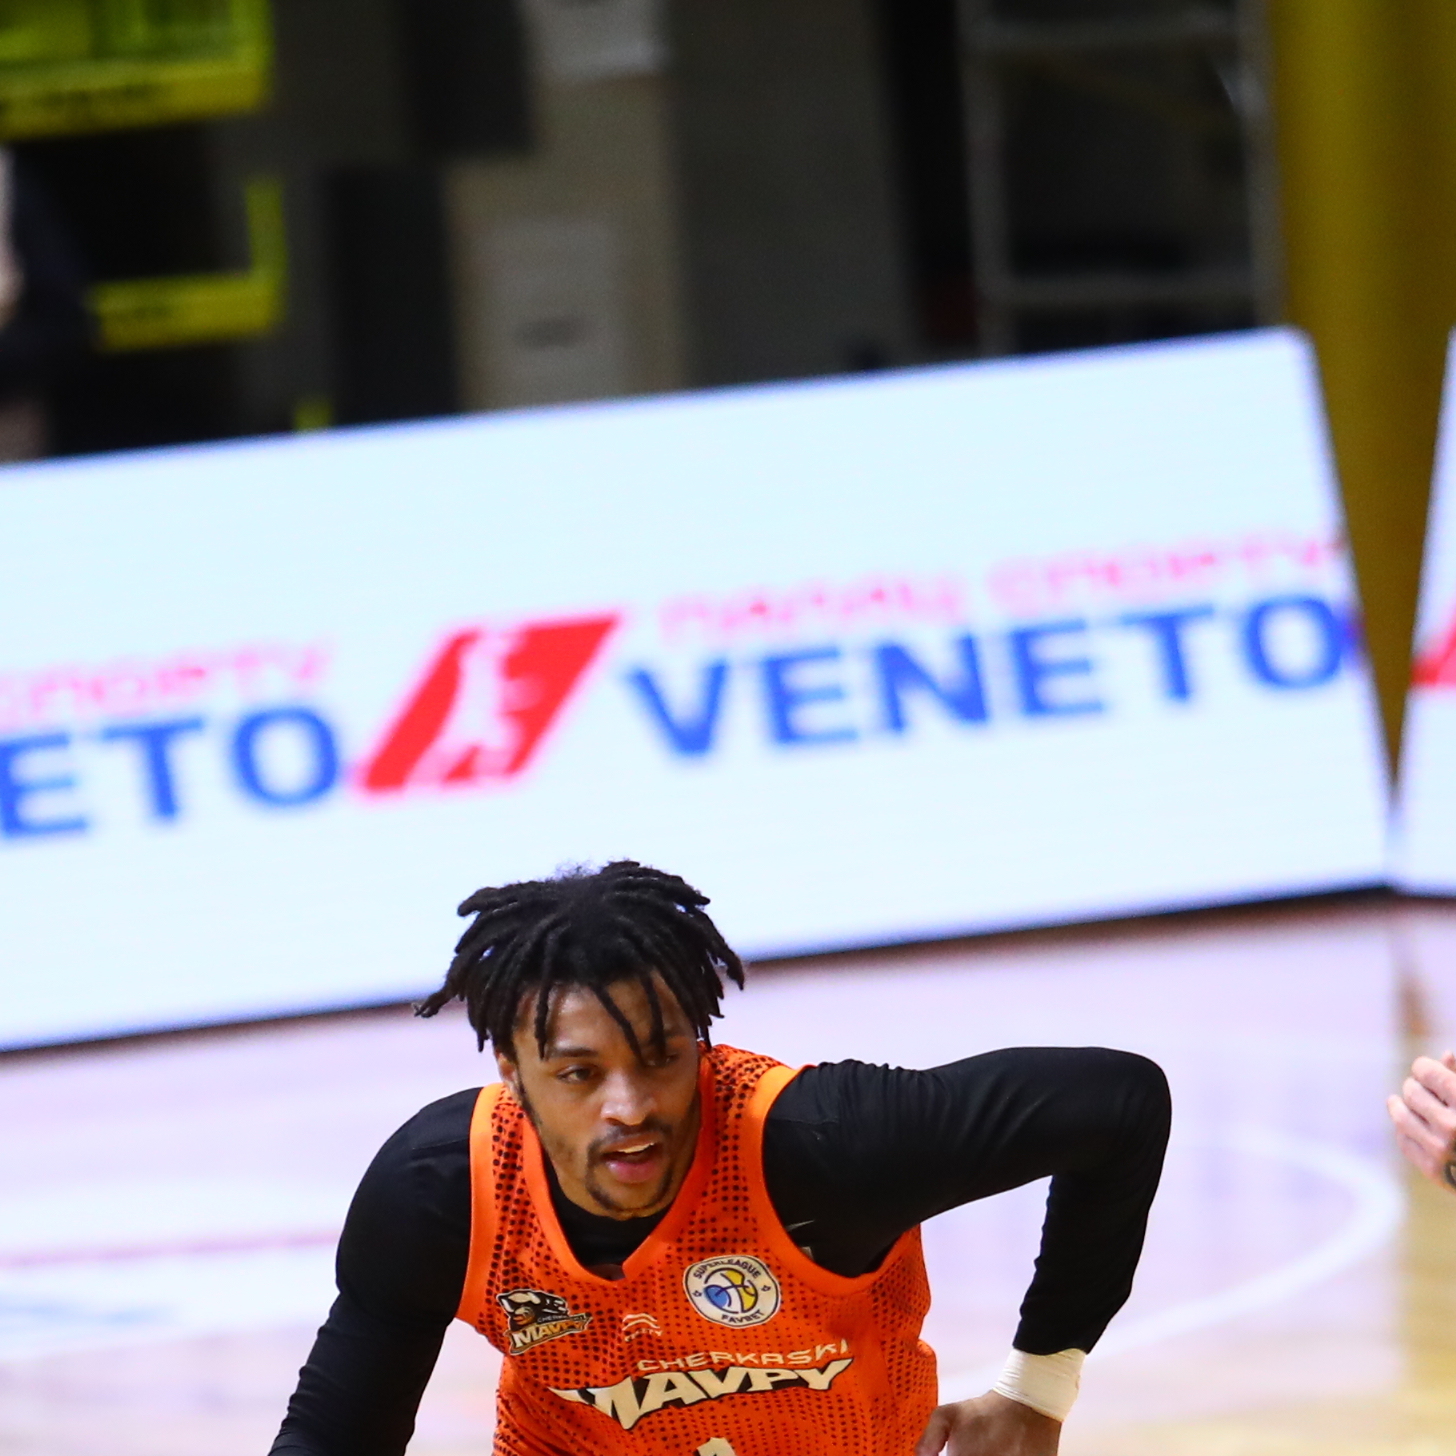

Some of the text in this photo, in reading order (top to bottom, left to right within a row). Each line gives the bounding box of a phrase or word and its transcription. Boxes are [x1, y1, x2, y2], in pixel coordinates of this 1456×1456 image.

[628, 594, 1358, 758] VENETO
[693, 1259, 762, 1280] SUPERLEAGUE
[721, 1309, 765, 1324] FAVBET
[636, 1338, 849, 1371] CHERKASKI
[547, 1357, 853, 1431] MAVPY
